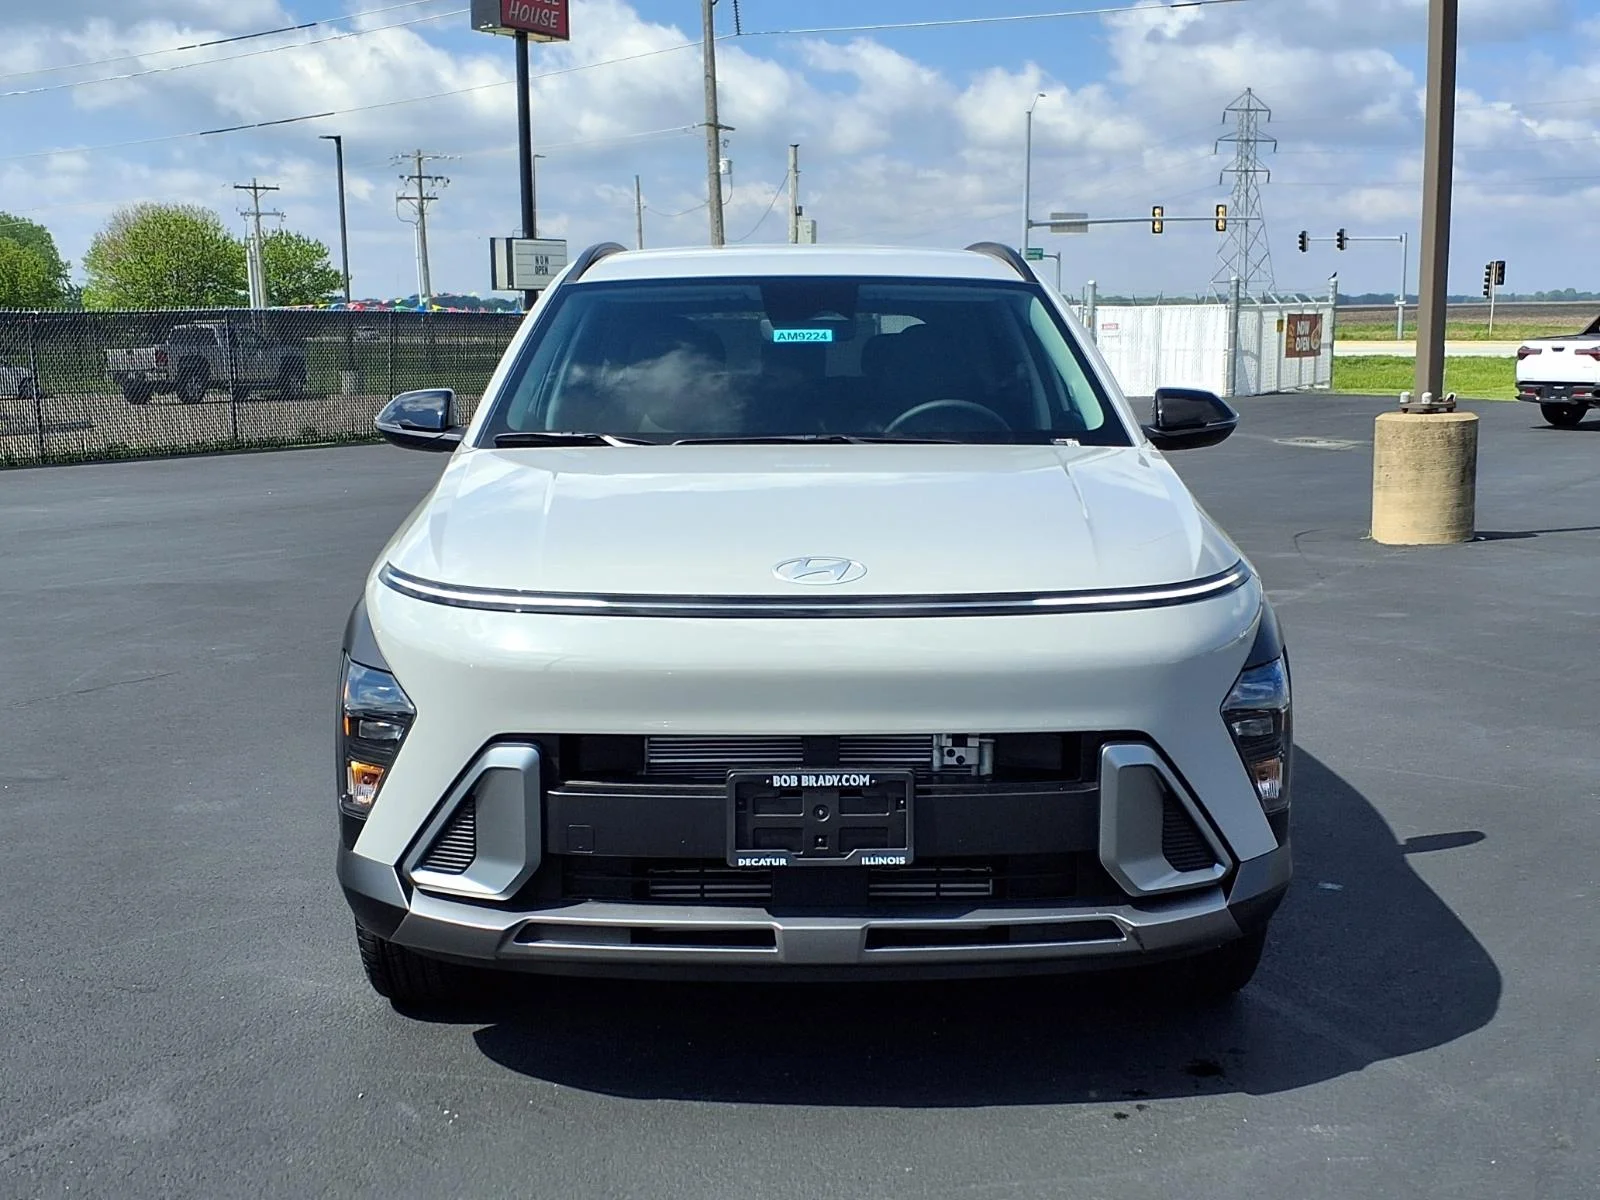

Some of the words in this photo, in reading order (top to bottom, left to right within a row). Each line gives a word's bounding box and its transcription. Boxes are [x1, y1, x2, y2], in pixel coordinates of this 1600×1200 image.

[508, 0, 560, 28] HOUSE
[534, 265, 549, 275] OPEN
[1296, 320, 1311, 336] NOW
[777, 332, 828, 341] AM9224
[1295, 336, 1310, 352] OPEN
[772, 774, 798, 787] BOB
[801, 774, 870, 787] BRADY.COM
[737, 858, 787, 866] DECATUR
[861, 856, 906, 865] ILLINOIS
